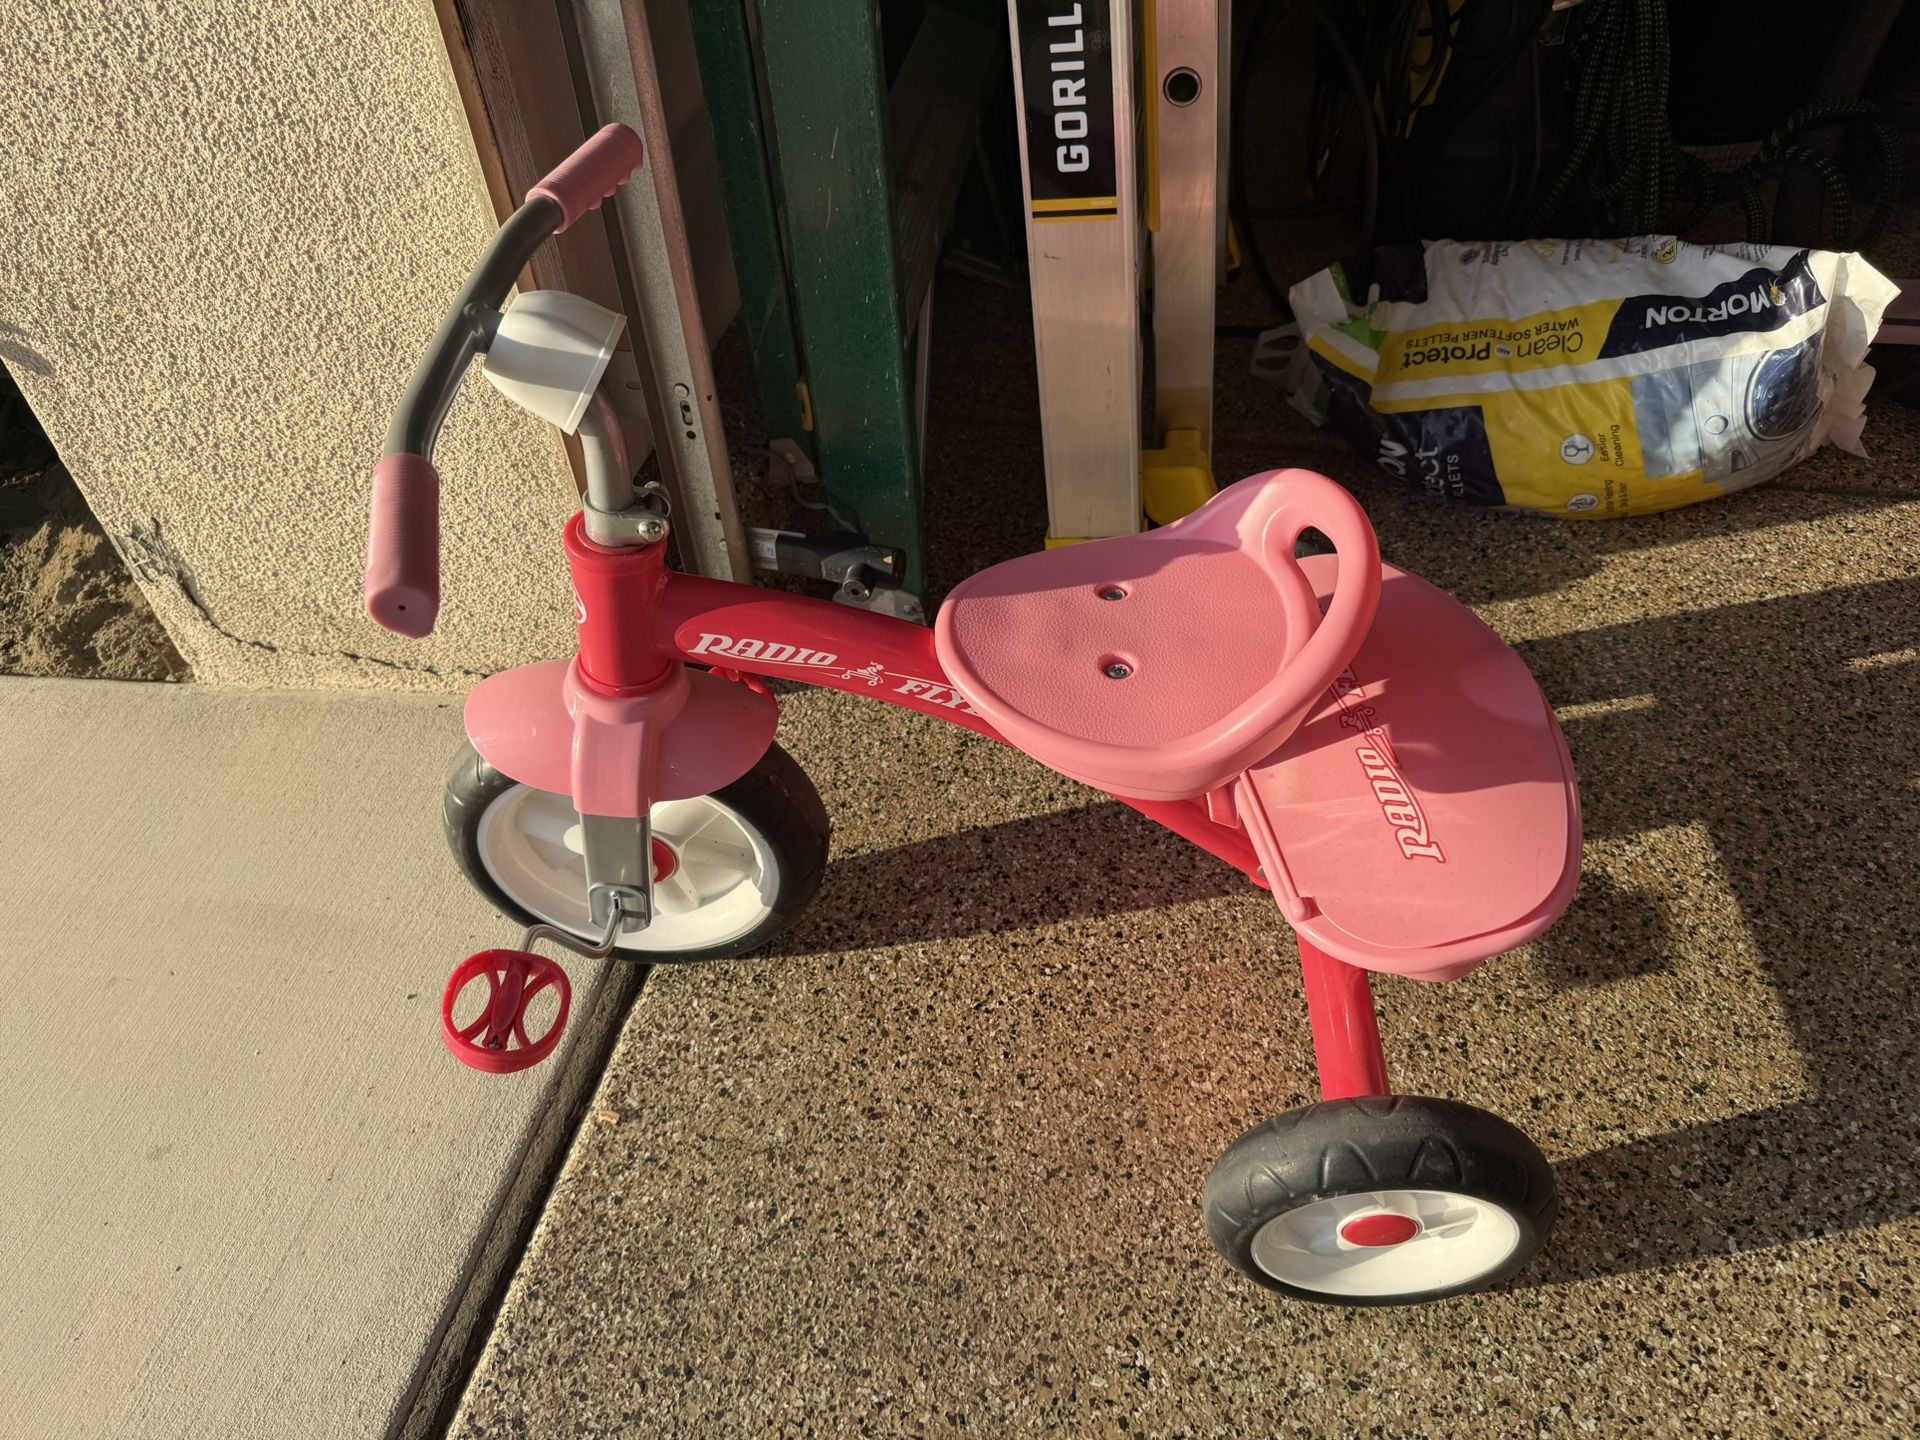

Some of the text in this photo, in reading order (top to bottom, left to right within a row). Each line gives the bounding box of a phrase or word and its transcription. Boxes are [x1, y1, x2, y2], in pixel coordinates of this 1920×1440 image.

[1048, 3, 1090, 173] GORILL
[1645, 285, 1771, 328] MORTON
[1405, 317, 1580, 349] WATER SOFTENER PELLETS
[1517, 332, 1584, 358] Clean
[1402, 341, 1491, 369] Protect
[1598, 433, 1610, 462] Easier
[1610, 424, 1624, 467] Cleaning
[688, 633, 980, 716] RADIO FLY
[1356, 747, 1447, 863] RADIO
